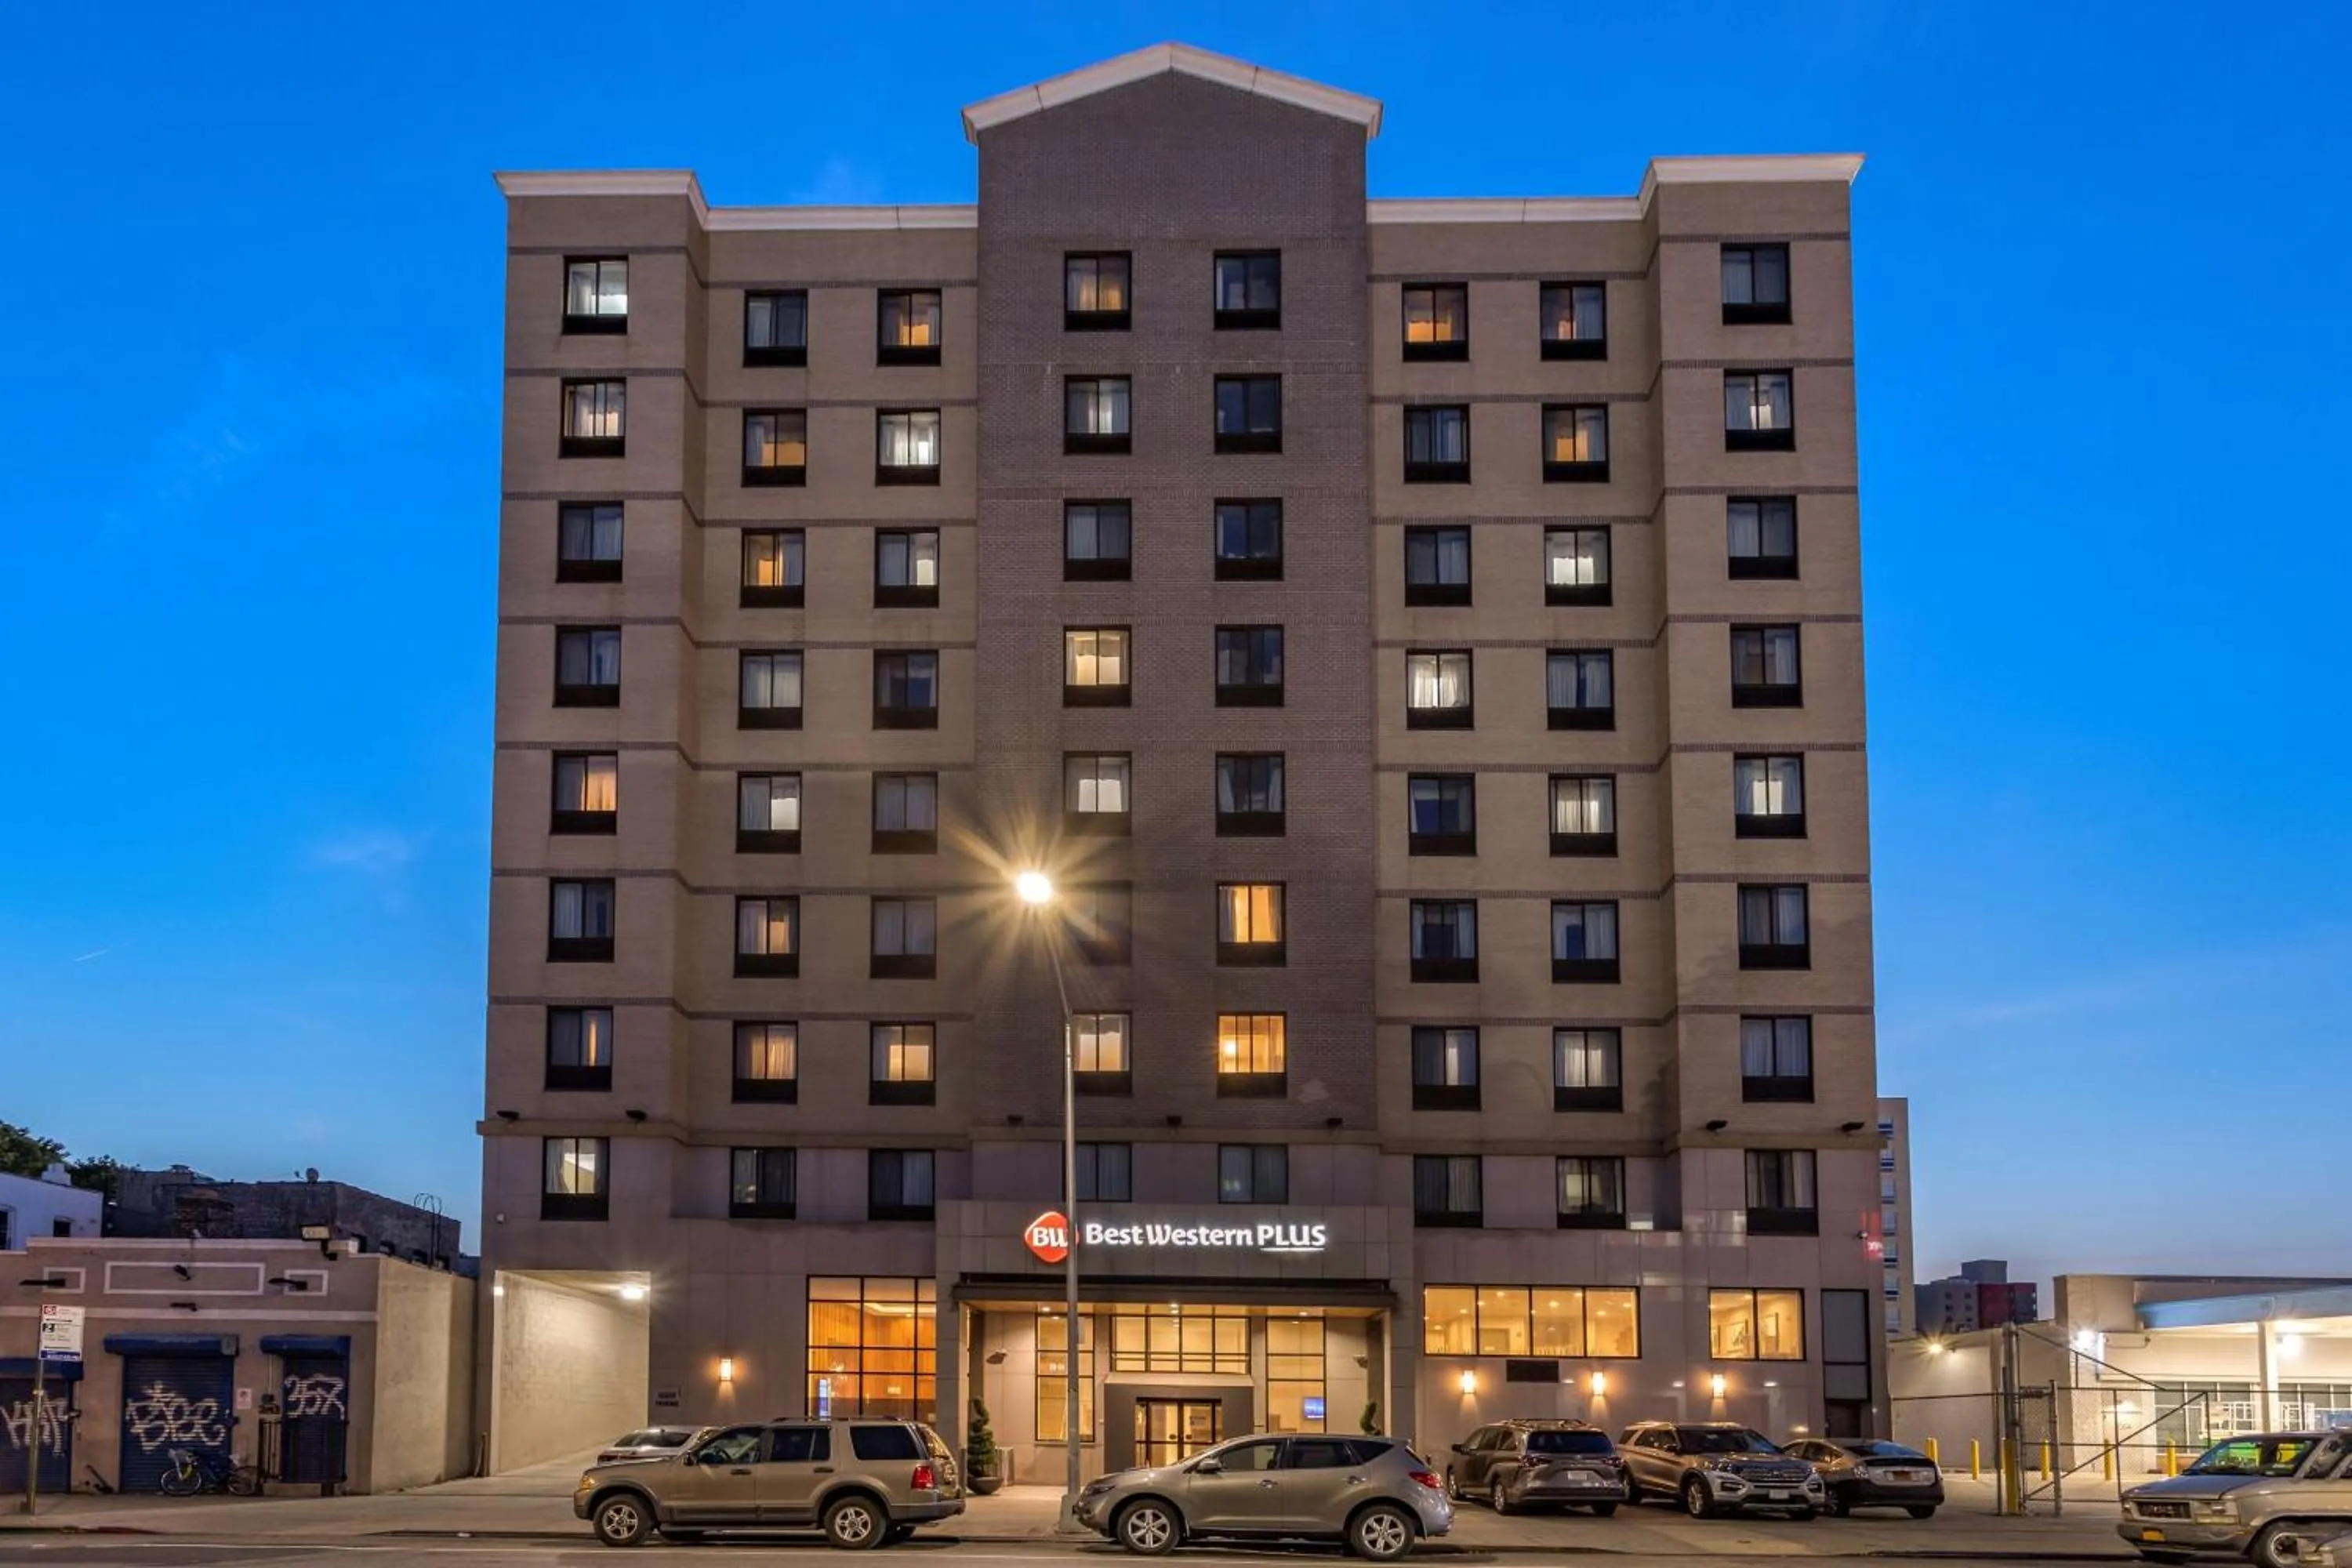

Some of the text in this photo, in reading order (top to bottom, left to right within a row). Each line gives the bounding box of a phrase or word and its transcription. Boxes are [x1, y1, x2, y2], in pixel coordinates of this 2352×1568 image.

[1086, 1223, 1327, 1247] Best Western PLUS
